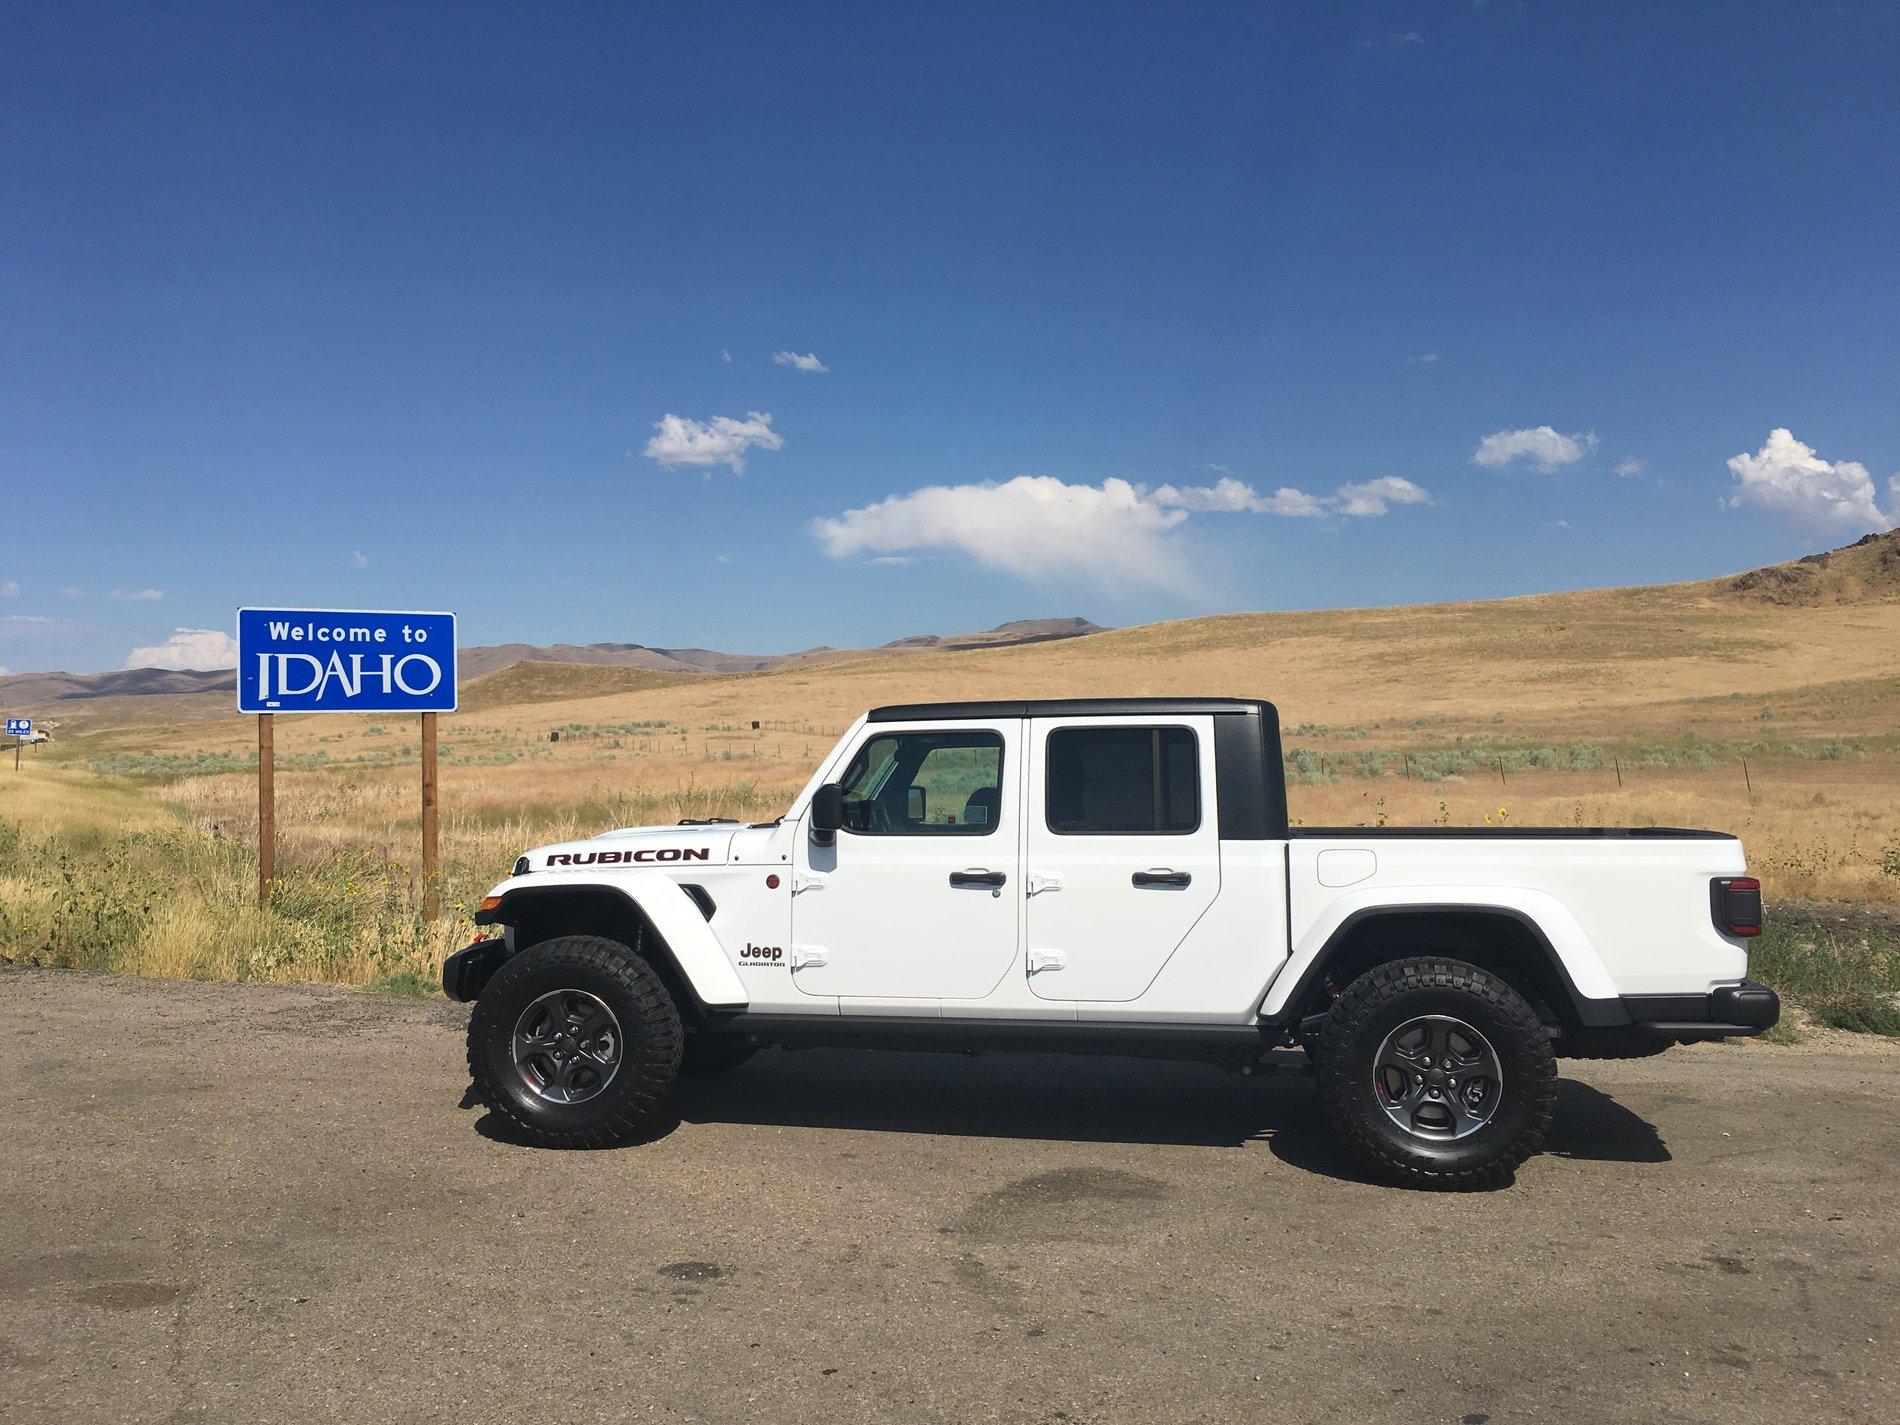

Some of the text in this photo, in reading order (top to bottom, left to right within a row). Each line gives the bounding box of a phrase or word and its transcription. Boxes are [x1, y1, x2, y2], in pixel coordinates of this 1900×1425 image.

[268, 621, 428, 643] Welcome to
[256, 649, 442, 702] IDAHO
[546, 848, 710, 867] RUBICON
[740, 943, 783, 961] Jeep
